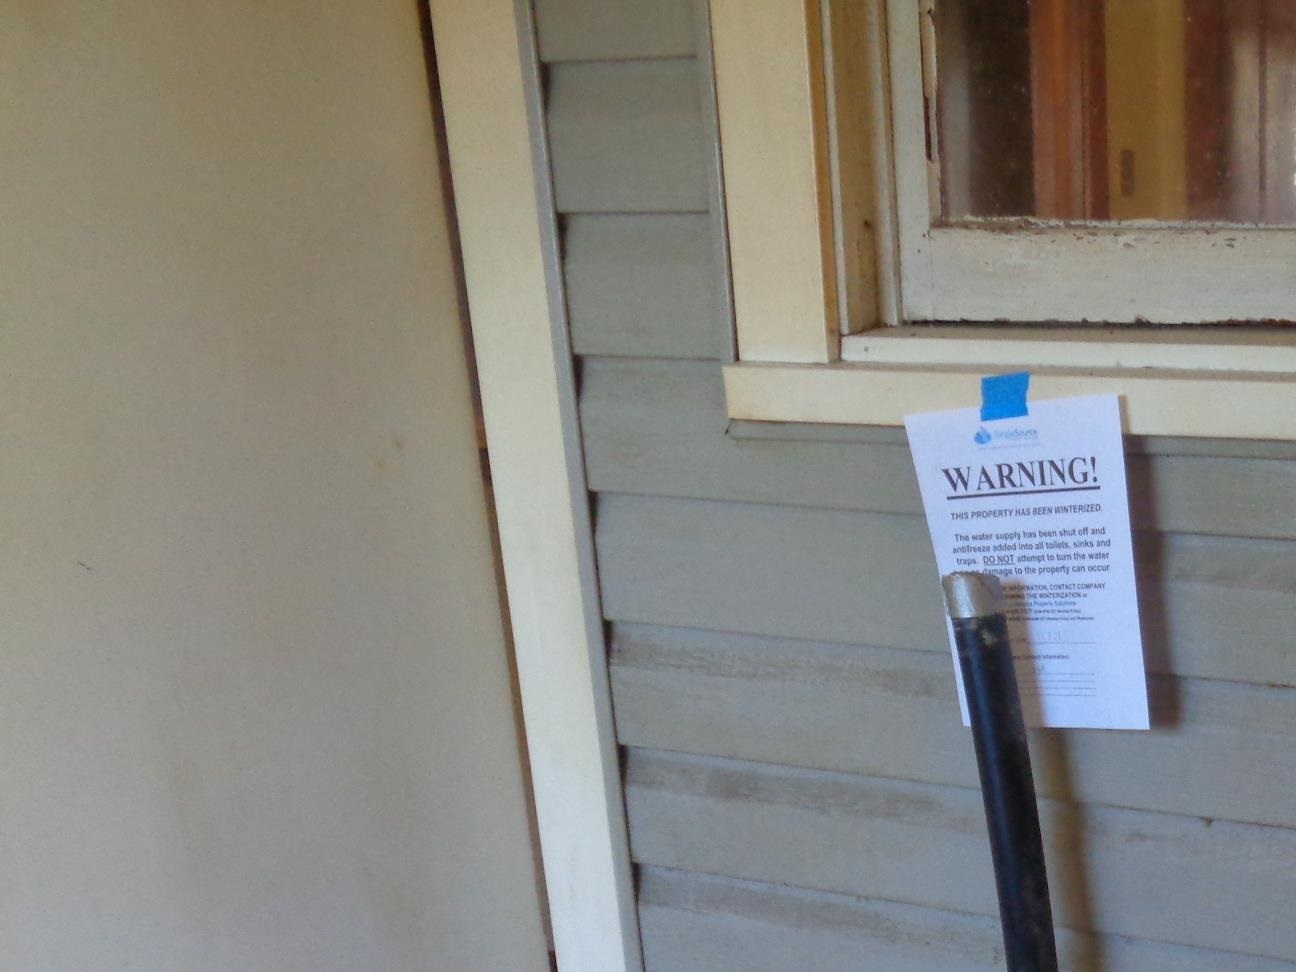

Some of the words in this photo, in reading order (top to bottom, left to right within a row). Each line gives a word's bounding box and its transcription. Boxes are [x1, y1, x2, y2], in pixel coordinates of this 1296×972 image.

[942, 456, 1098, 492] WARNING!
[951, 511, 969, 520] THIS
[971, 509, 1013, 519] PROPERTY
[1015, 508, 1031, 517] HAS
[1033, 507, 1053, 516] BEEN
[1054, 504, 1102, 514] WINTERIZED.
[955, 533, 970, 542] The
[972, 533, 993, 541] water
[995, 531, 1021, 541] supply
[1023, 530, 1037, 539] has
[1039, 530, 1057, 538] been
[1059, 528, 1076, 537] shut
[1078, 527, 1089, 536] off
[1091, 526, 1106, 535] and
[953, 545, 991, 554] antifreeze
[993, 543, 1017, 552] added
[1018, 542, 1033, 550] into
[1035, 542, 1044, 550] all
[1046, 541, 1071, 550] toilets,
[1073, 539, 1094, 548] sinks
[1096, 539, 1111, 548] and
[983, 555, 995, 564] DO
[997, 554, 1015, 563] NOT
[1017, 554, 1045, 563] attempt
[1047, 553, 1055, 561] to
[1056, 553, 1071, 561] turn
[1073, 552, 1086, 560] the
[1088, 551, 1110, 560] water
[1015, 567, 1023, 575] to
[1025, 566, 1037, 574] the
[1039, 565, 1070, 575] property
[1072, 565, 1086, 573] can
[1088, 563, 1110, 572] occur
[1050, 583, 1075, 591] CONTACT
[1077, 581, 1106, 590] COMPANY
[1039, 591, 1081, 599] WINTERIZATION
